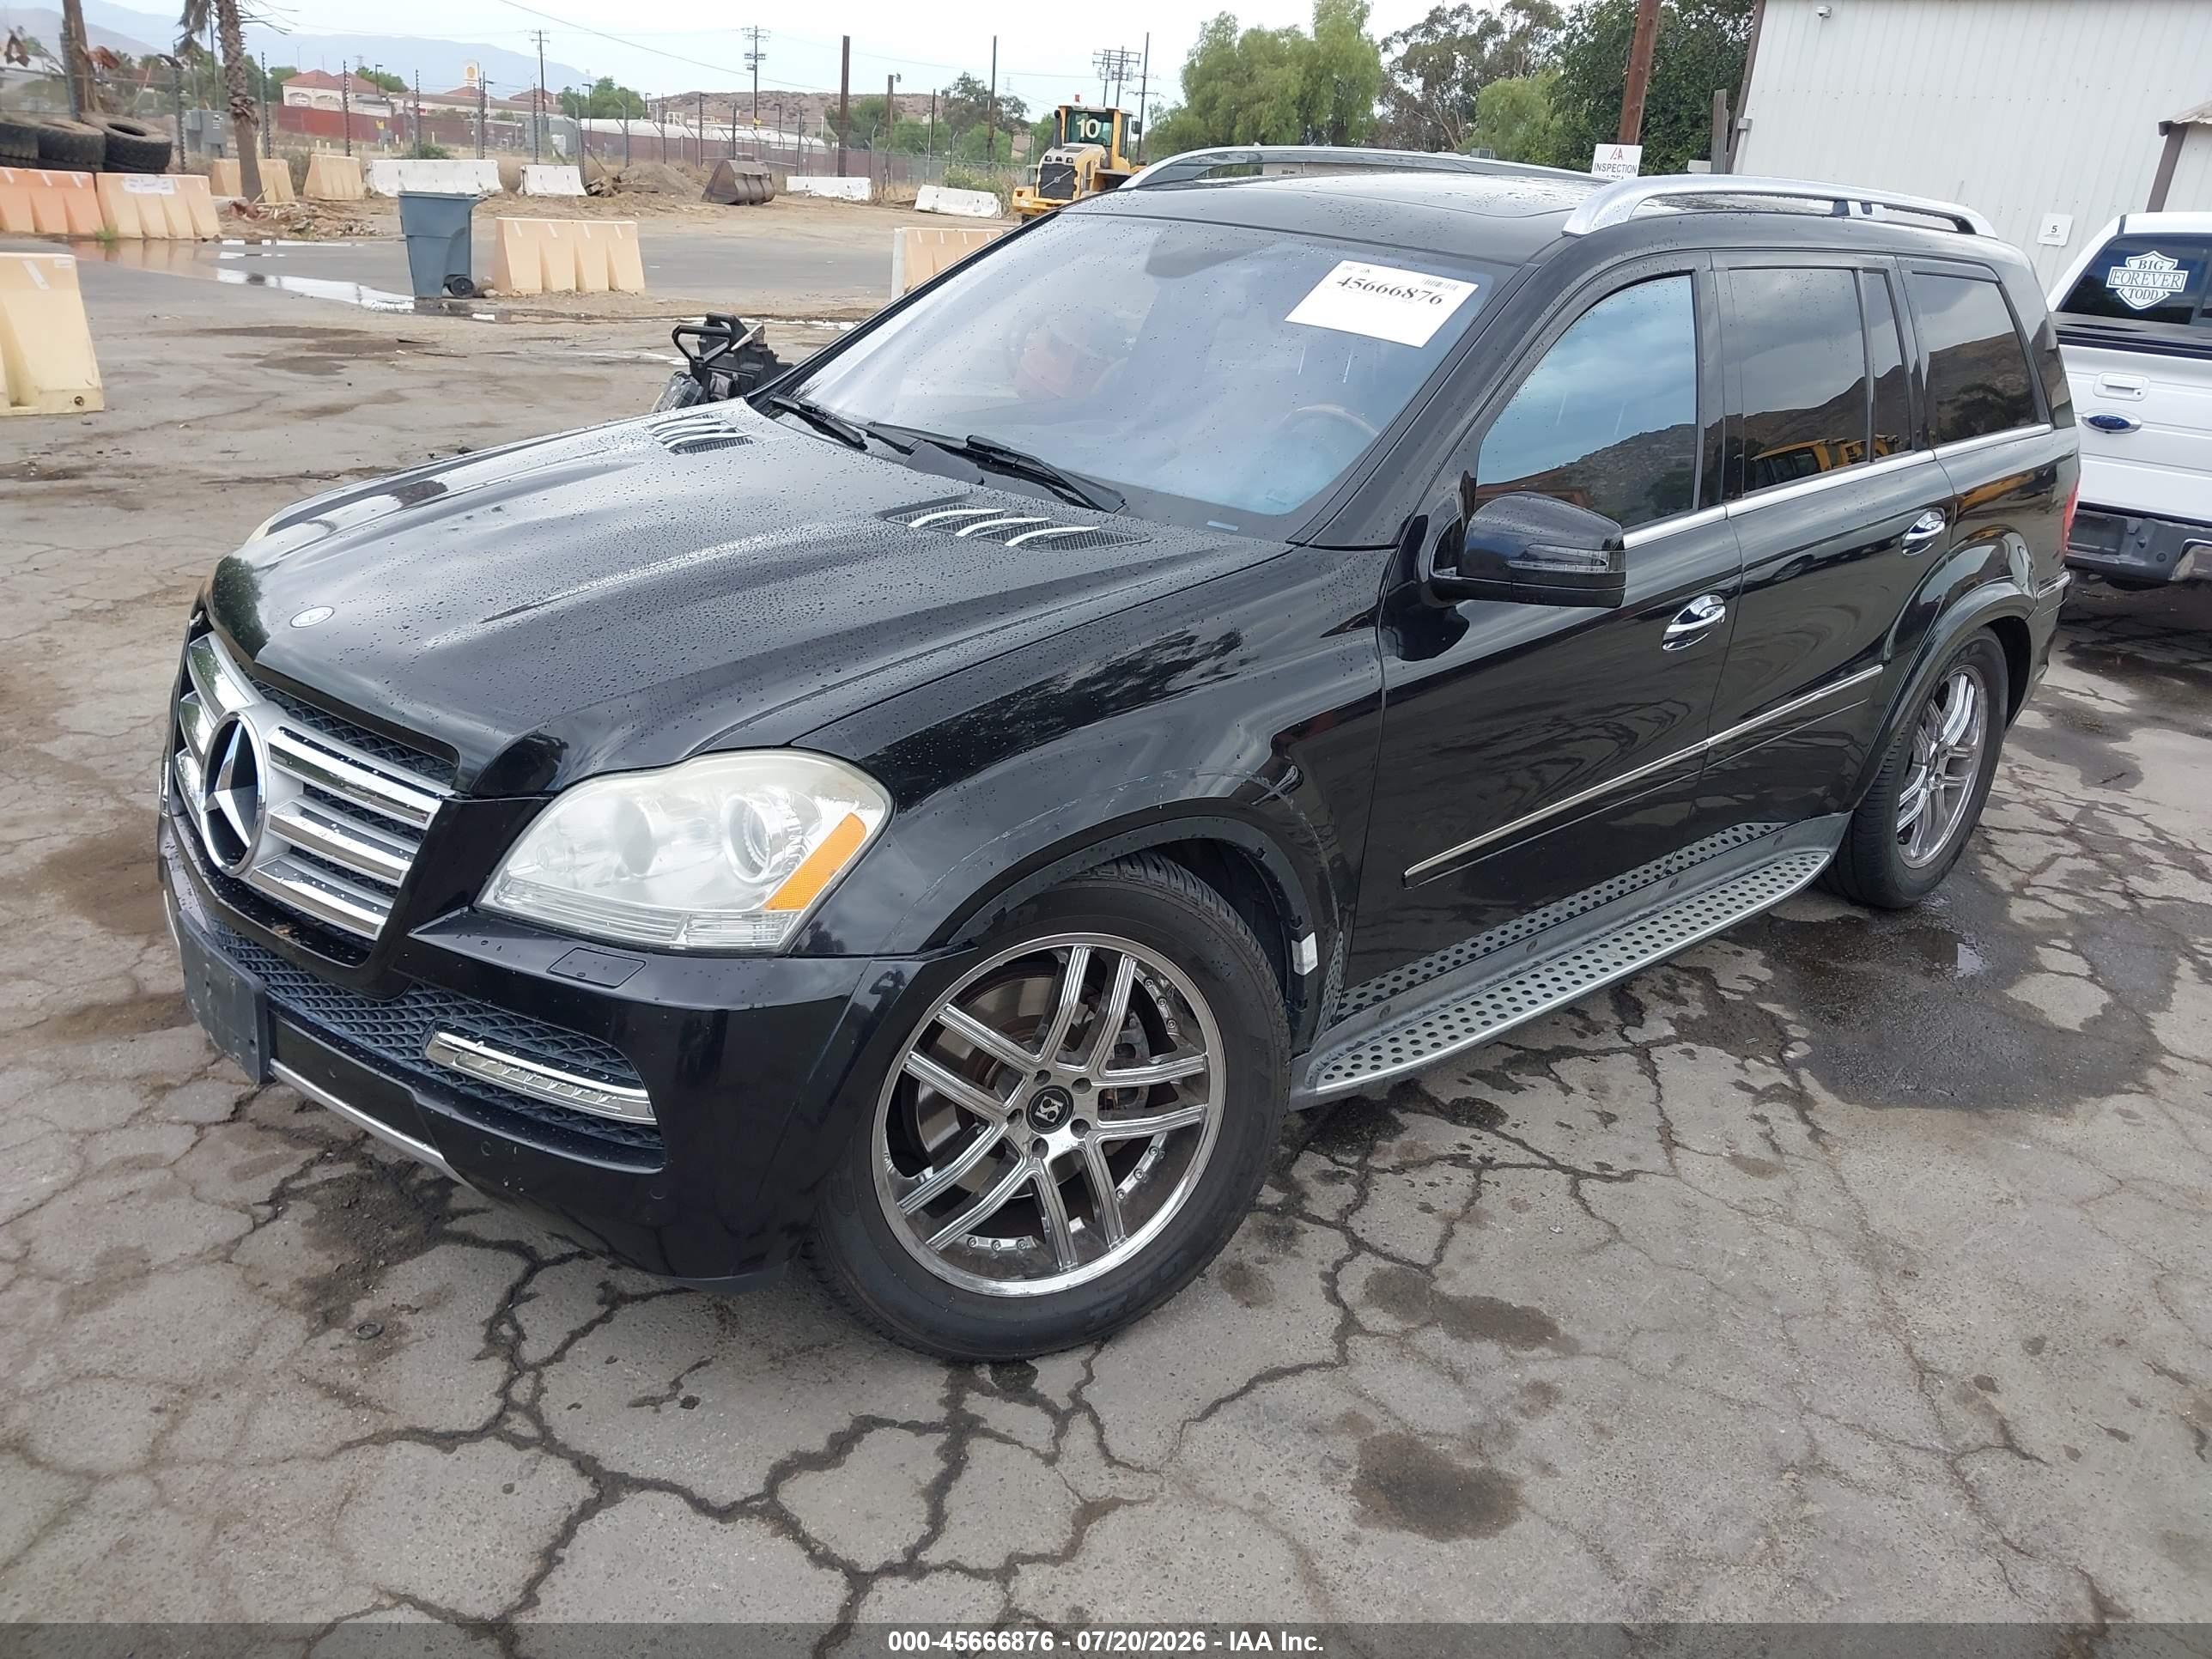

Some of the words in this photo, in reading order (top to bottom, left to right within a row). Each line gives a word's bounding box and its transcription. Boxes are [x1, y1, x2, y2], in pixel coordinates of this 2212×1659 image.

[1077, 118, 1100, 138] 10
[1594, 162, 1638, 173] INSPECTION
[2051, 225, 2058, 234] 5
[2137, 259, 2164, 270] BIG
[2112, 270, 2181, 288] FOREVER
[1336, 276, 1445, 305] 45666876
[2129, 288, 2158, 301] TODD
